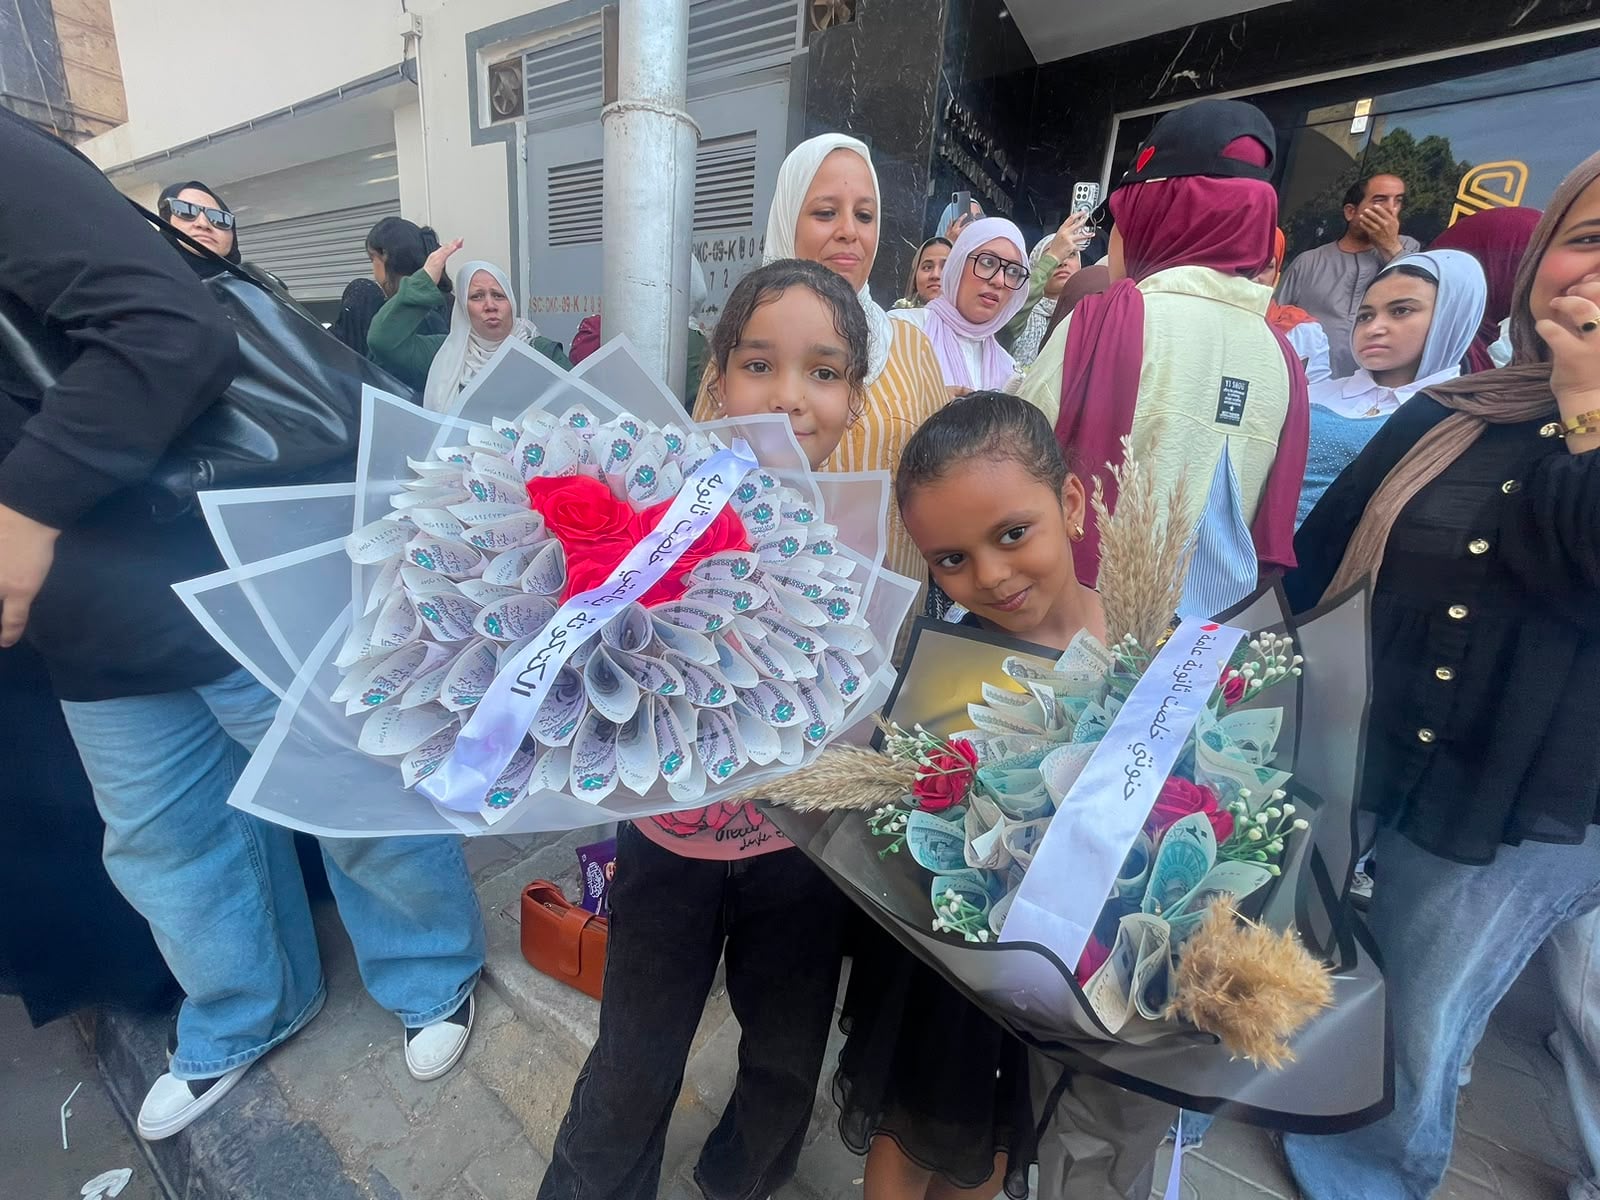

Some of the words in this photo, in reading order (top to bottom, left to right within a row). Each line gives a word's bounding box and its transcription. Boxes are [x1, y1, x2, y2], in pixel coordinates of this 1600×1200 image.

[510, 612, 596, 697] الكتكوتة
[584, 570, 641, 607] بتاعتي
[649, 520, 692, 566] خلصت
[1124, 742, 1153, 801] حنونتي
[1150, 696, 1179, 740] خلصت
[1172, 659, 1203, 693] ثانوية
[1190, 634, 1217, 656] عامة
